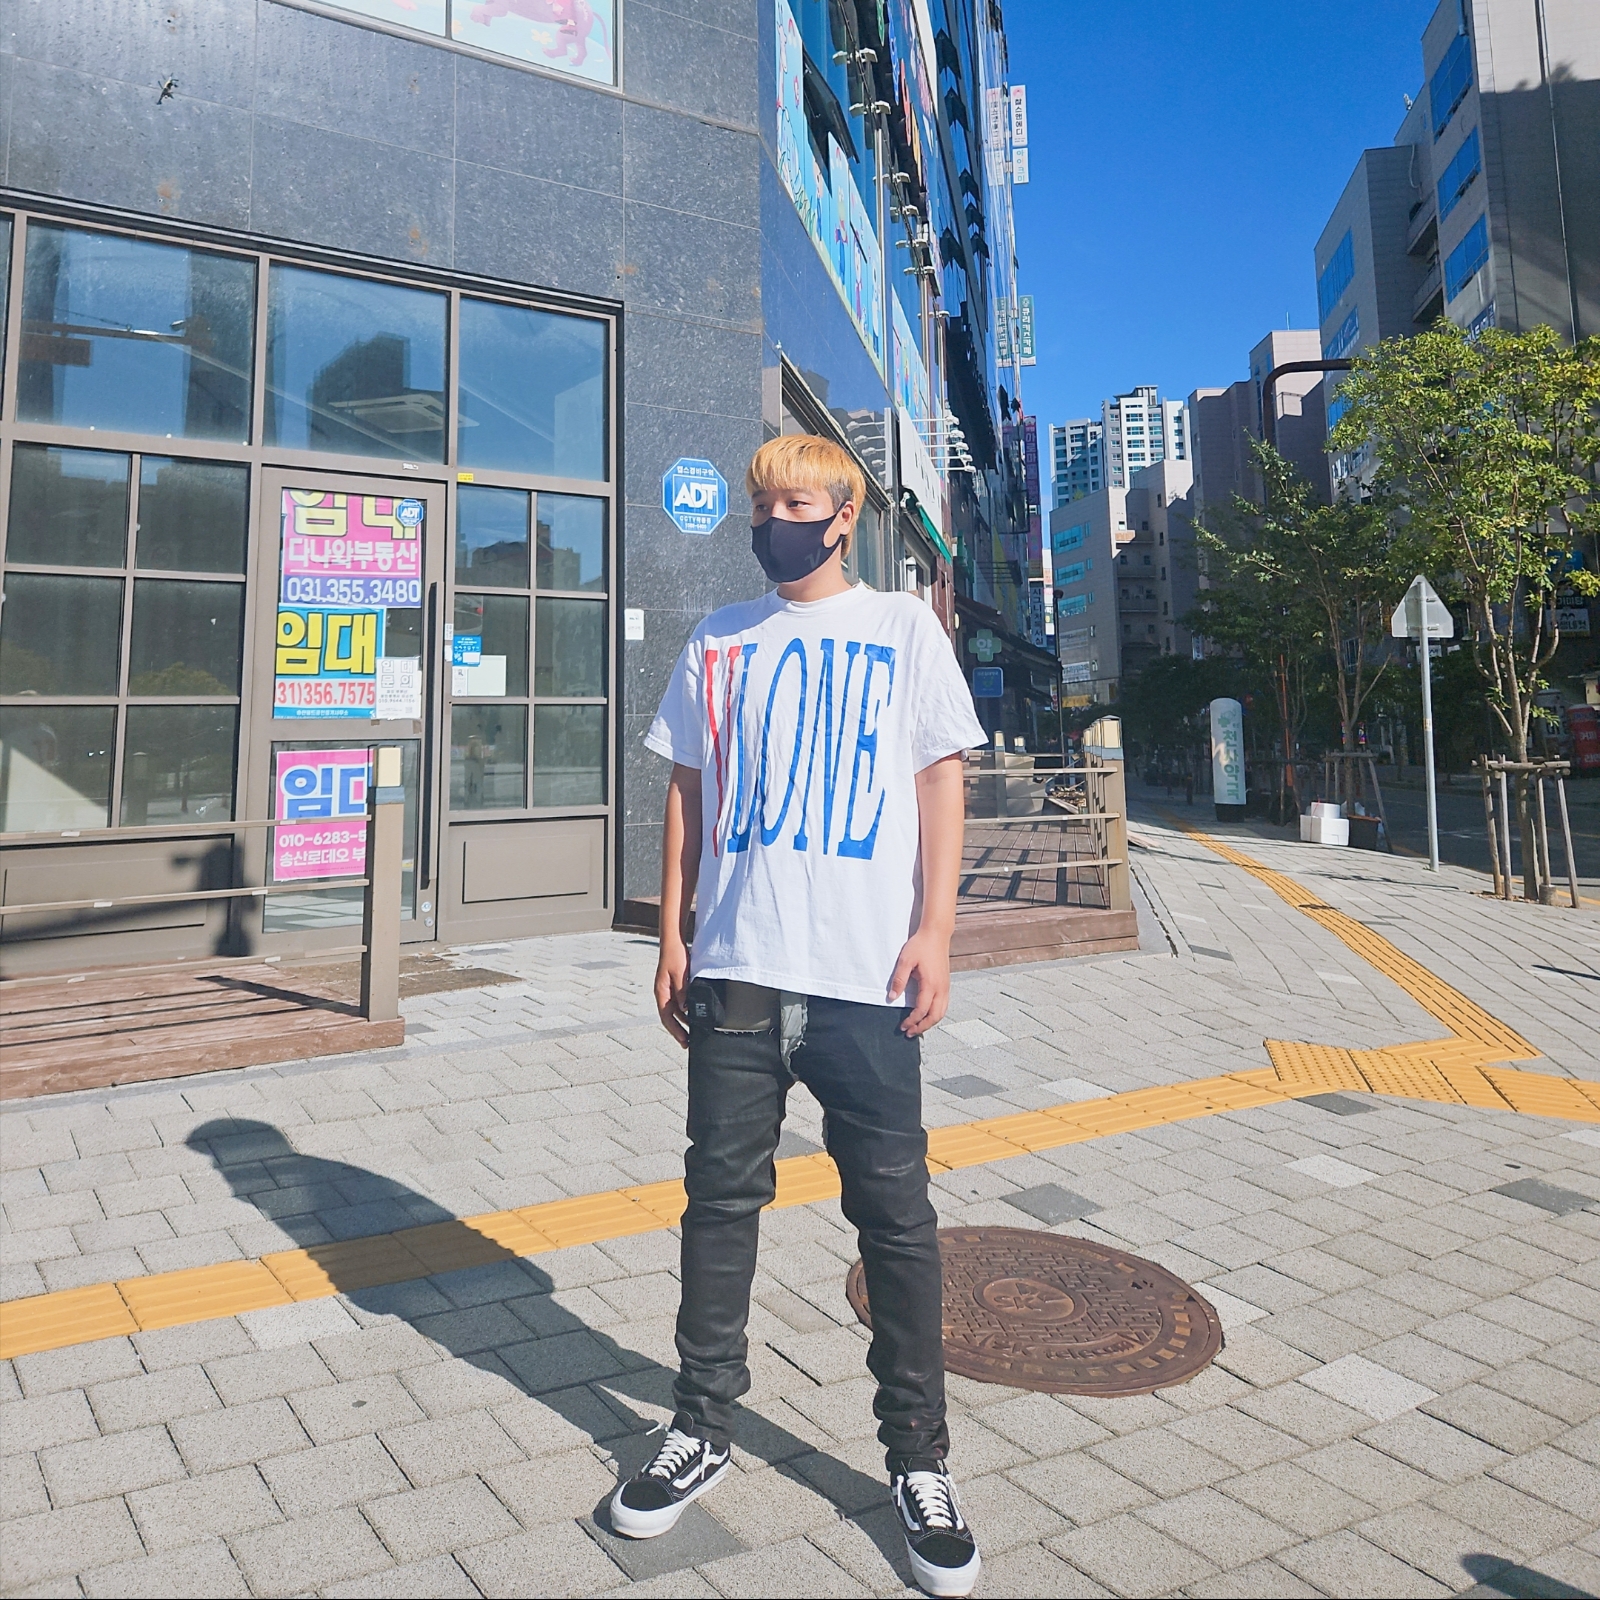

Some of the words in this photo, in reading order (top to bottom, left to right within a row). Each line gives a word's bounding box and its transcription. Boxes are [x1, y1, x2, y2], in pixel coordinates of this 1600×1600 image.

[674, 482, 717, 509] ADT
[401, 507, 420, 518] ADT
[287, 577, 421, 604] 031.355.3480
[275, 611, 378, 675] 임대
[976, 638, 993, 656] 약
[705, 638, 896, 860] VLONE
[279, 847, 350, 868] 송산로데오
